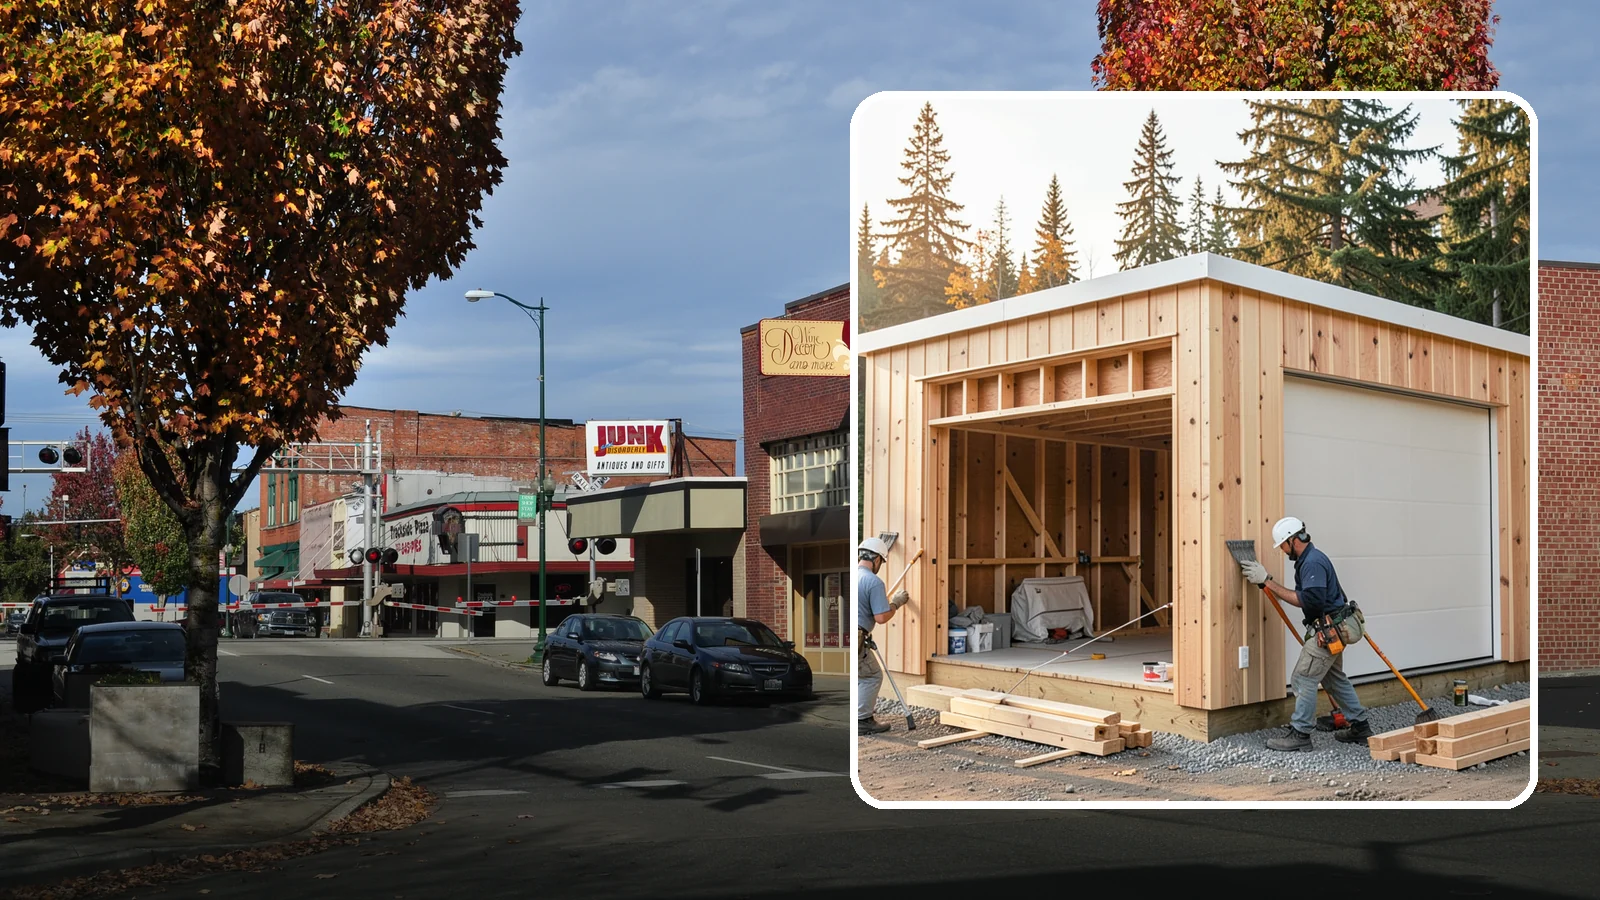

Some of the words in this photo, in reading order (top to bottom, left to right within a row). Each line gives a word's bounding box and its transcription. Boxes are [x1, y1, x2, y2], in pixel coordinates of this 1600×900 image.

[595, 425, 665, 457] JUNK
[607, 446, 645, 454] DISORDERLY
[597, 461, 628, 470] ANTIQUES
[631, 461, 643, 470] AND
[647, 460, 665, 470] GIFTS
[590, 476, 608, 491] SING
[390, 521, 413, 540] Trackside
[415, 519, 429, 535] Pizza
